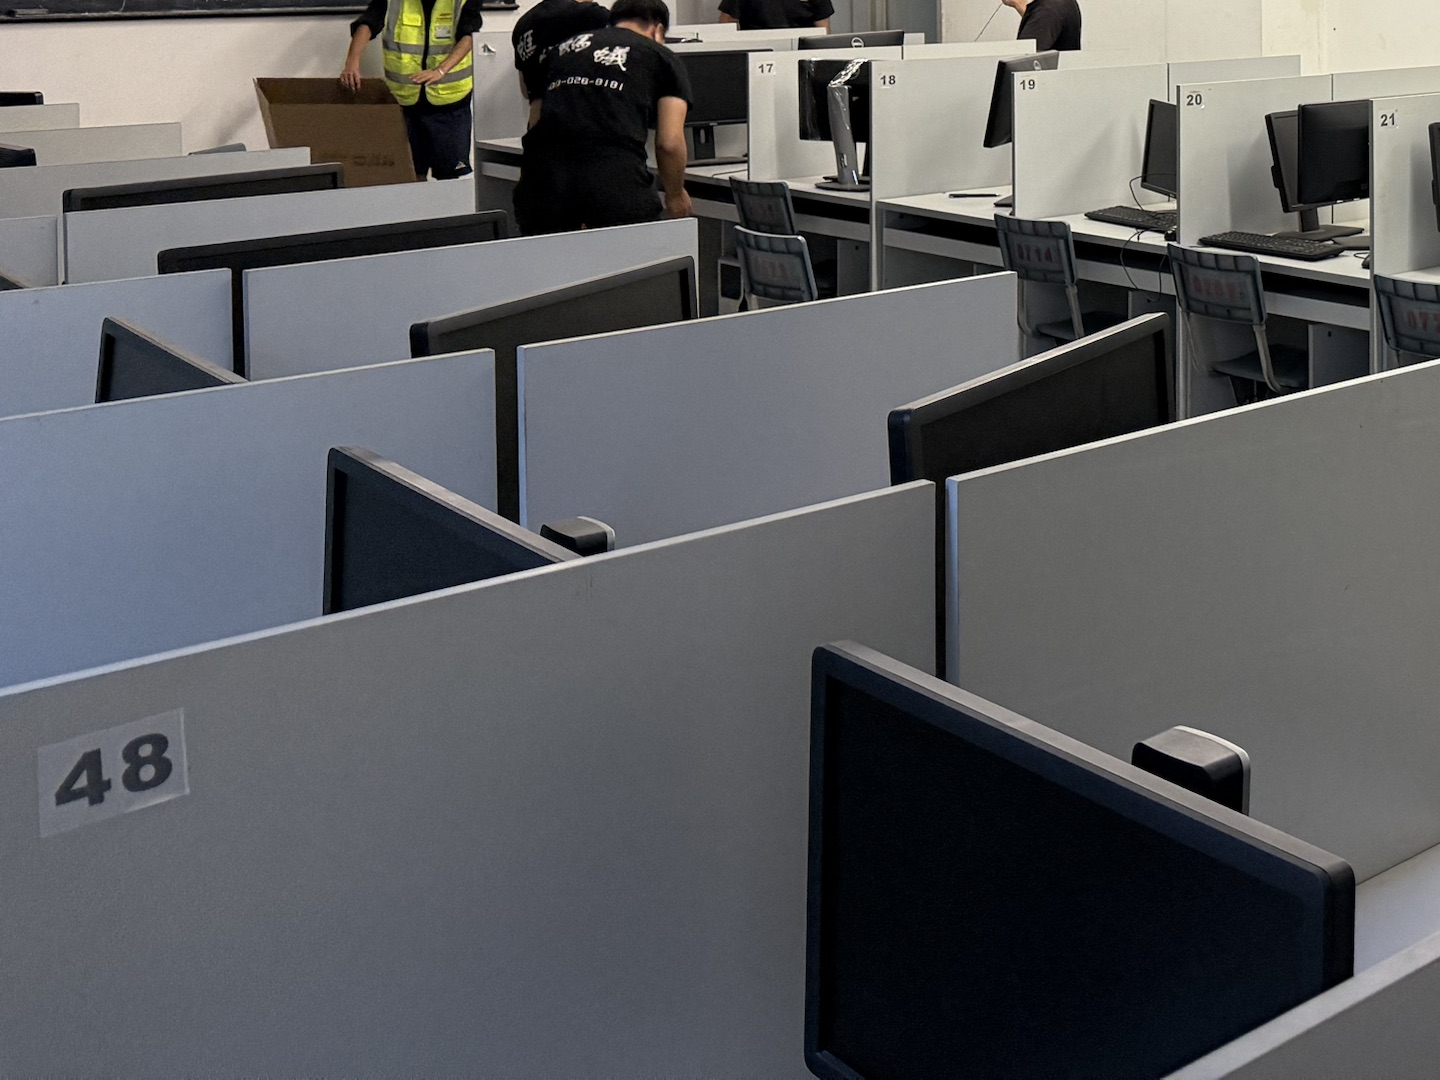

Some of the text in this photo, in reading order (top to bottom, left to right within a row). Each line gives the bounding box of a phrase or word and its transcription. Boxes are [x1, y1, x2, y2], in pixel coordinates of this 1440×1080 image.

[758, 63, 774, 73] 17
[548, 76, 624, 91] 00-028-8181
[880, 75, 896, 86] 18
[1019, 79, 1036, 91] 19
[1186, 94, 1202, 106] 20
[1380, 113, 1395, 127] 21
[54, 732, 173, 807] 48
